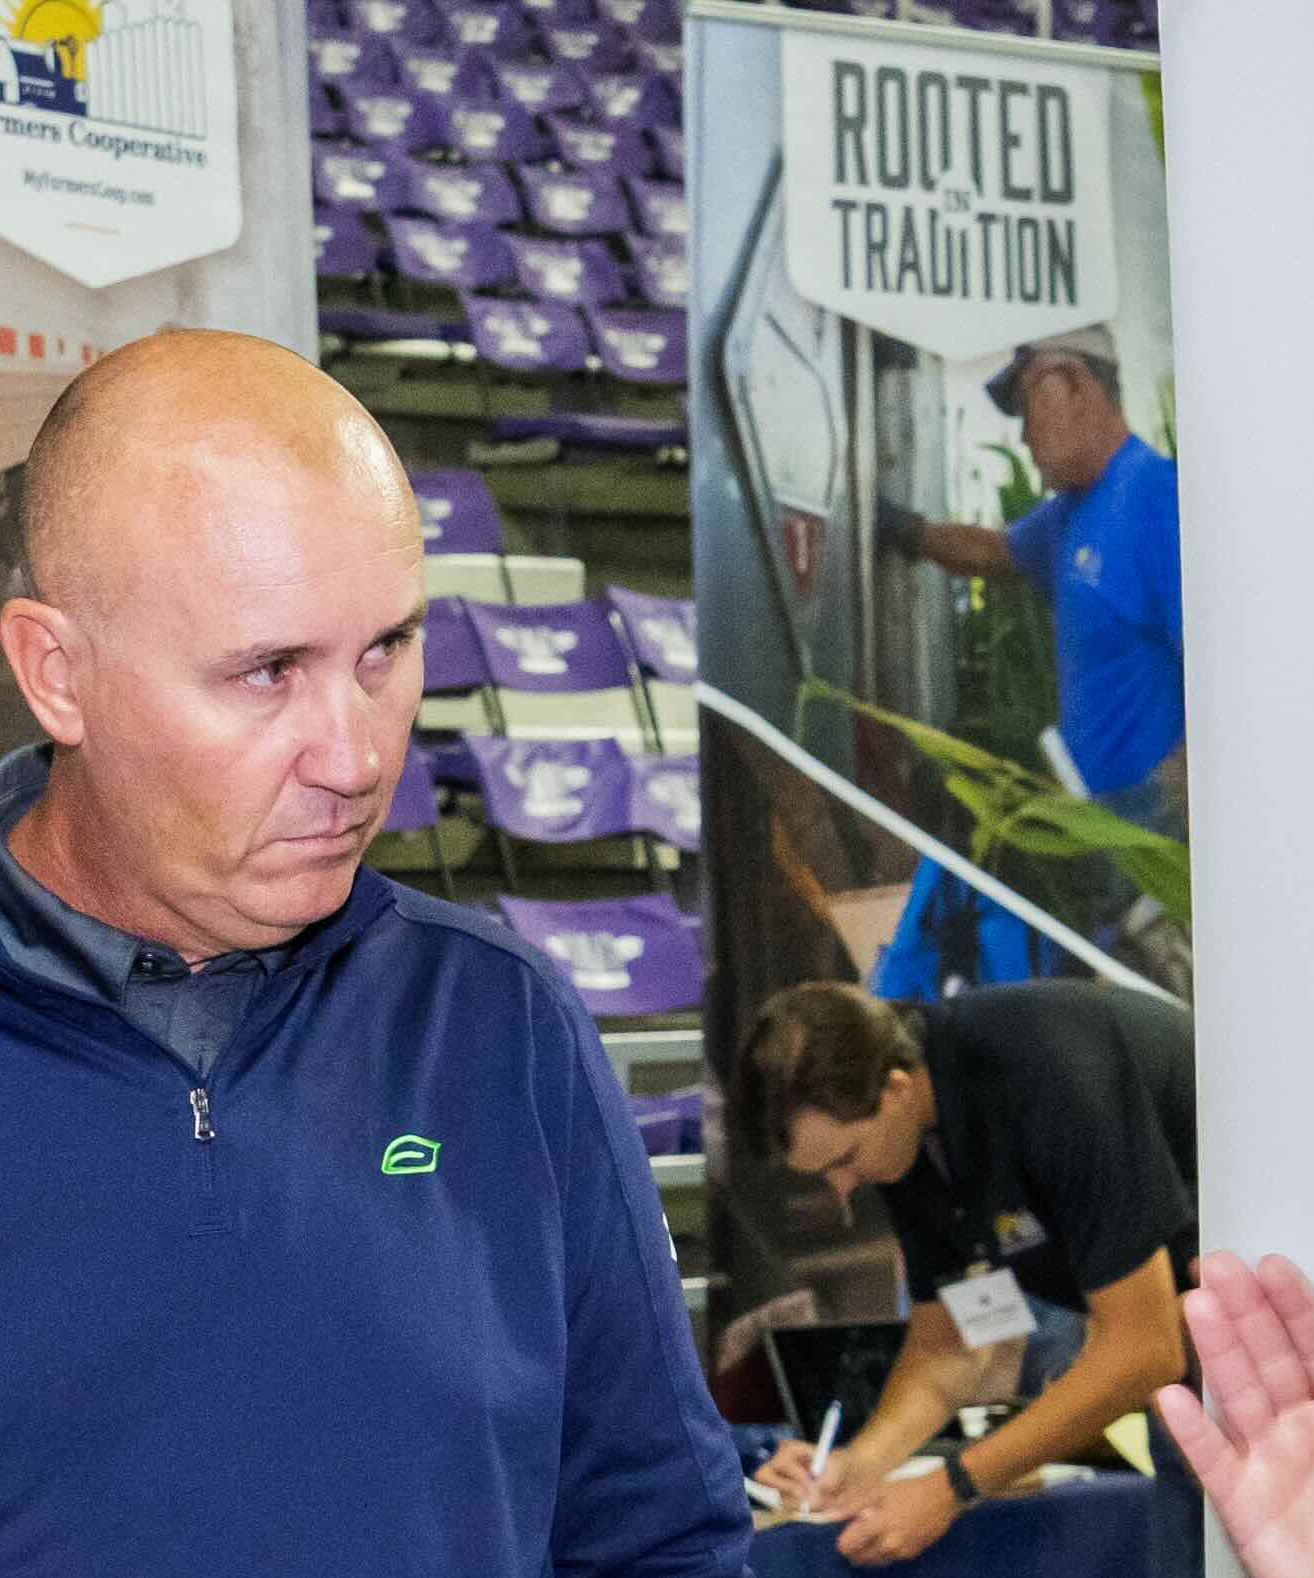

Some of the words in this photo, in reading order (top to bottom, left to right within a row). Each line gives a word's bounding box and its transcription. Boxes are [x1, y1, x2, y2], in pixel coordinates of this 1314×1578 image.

[68, 125, 209, 168] Cooperative
[832, 60, 1076, 205] ROOTED
[832, 200, 1077, 305] TRADITION
